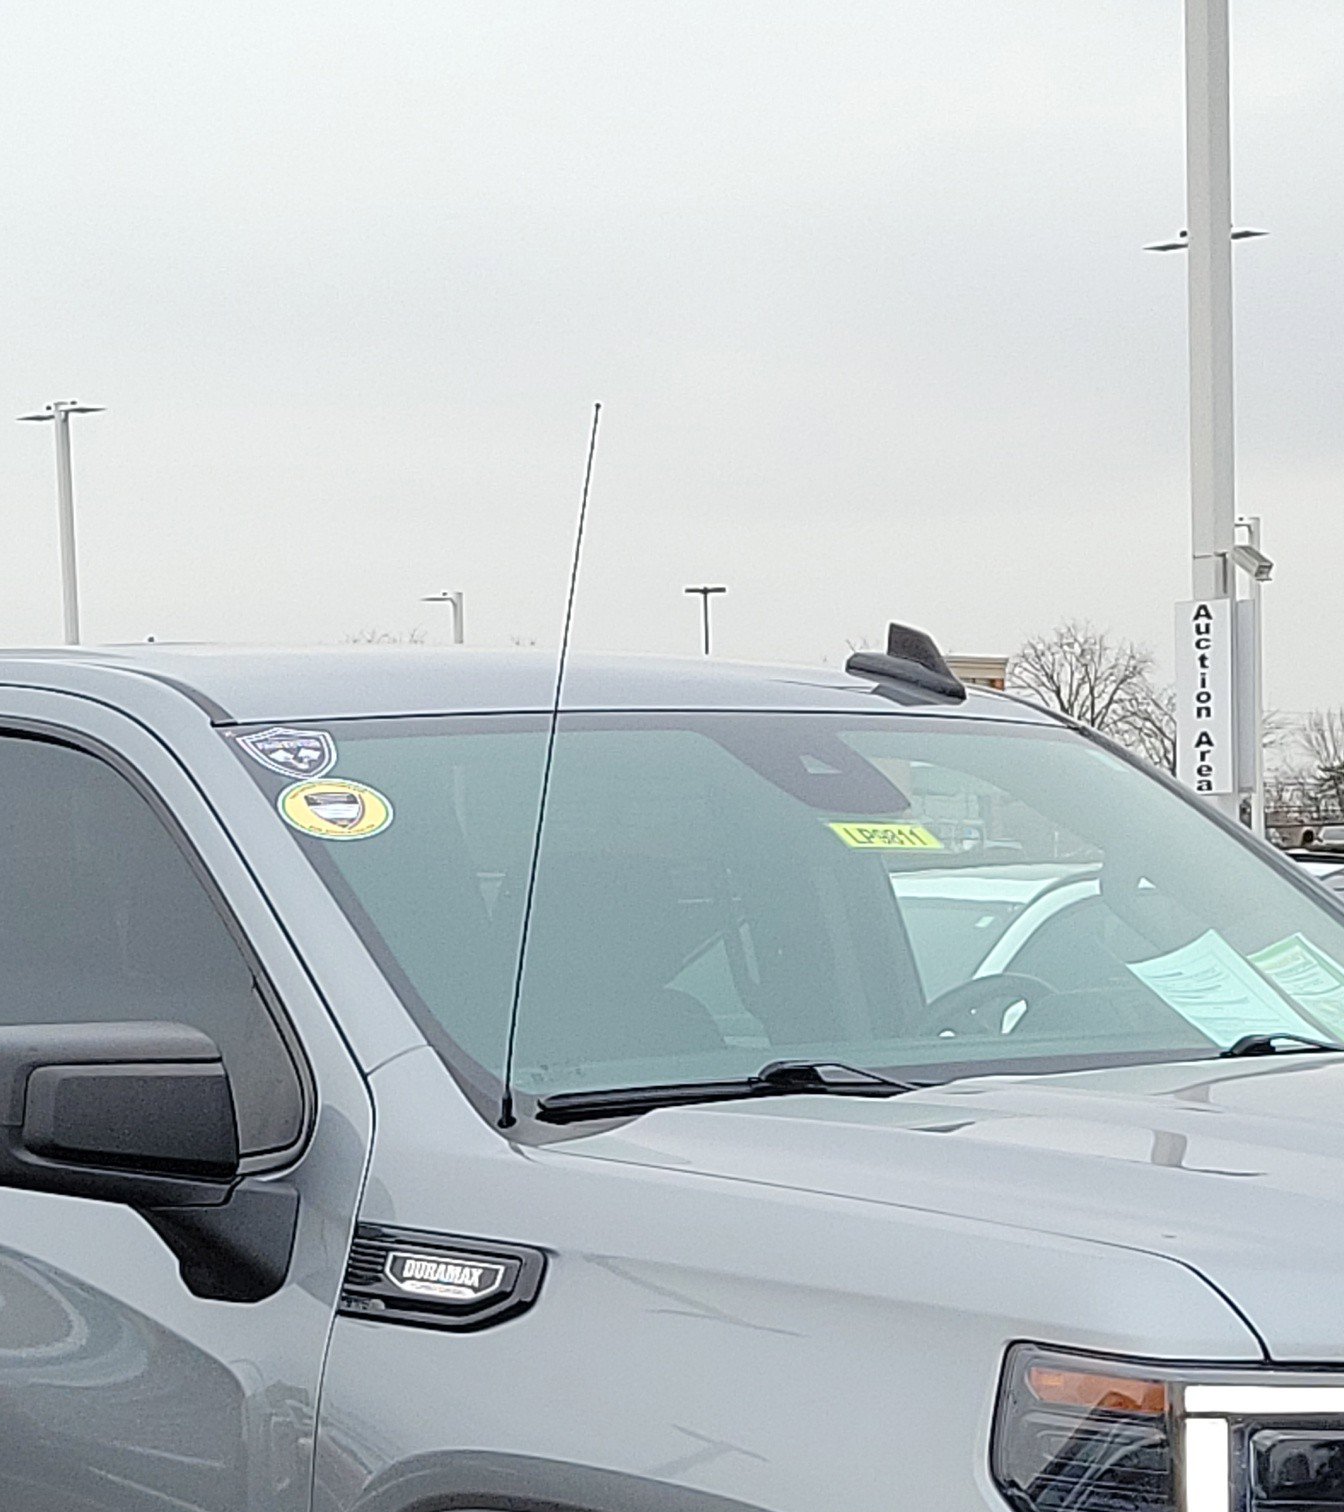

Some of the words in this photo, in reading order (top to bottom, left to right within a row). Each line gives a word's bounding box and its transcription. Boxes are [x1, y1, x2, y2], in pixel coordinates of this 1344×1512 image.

[1193, 604, 1213, 718] Auction
[1195, 731, 1214, 791] Area
[402, 1259, 485, 1288] DURAMAX
